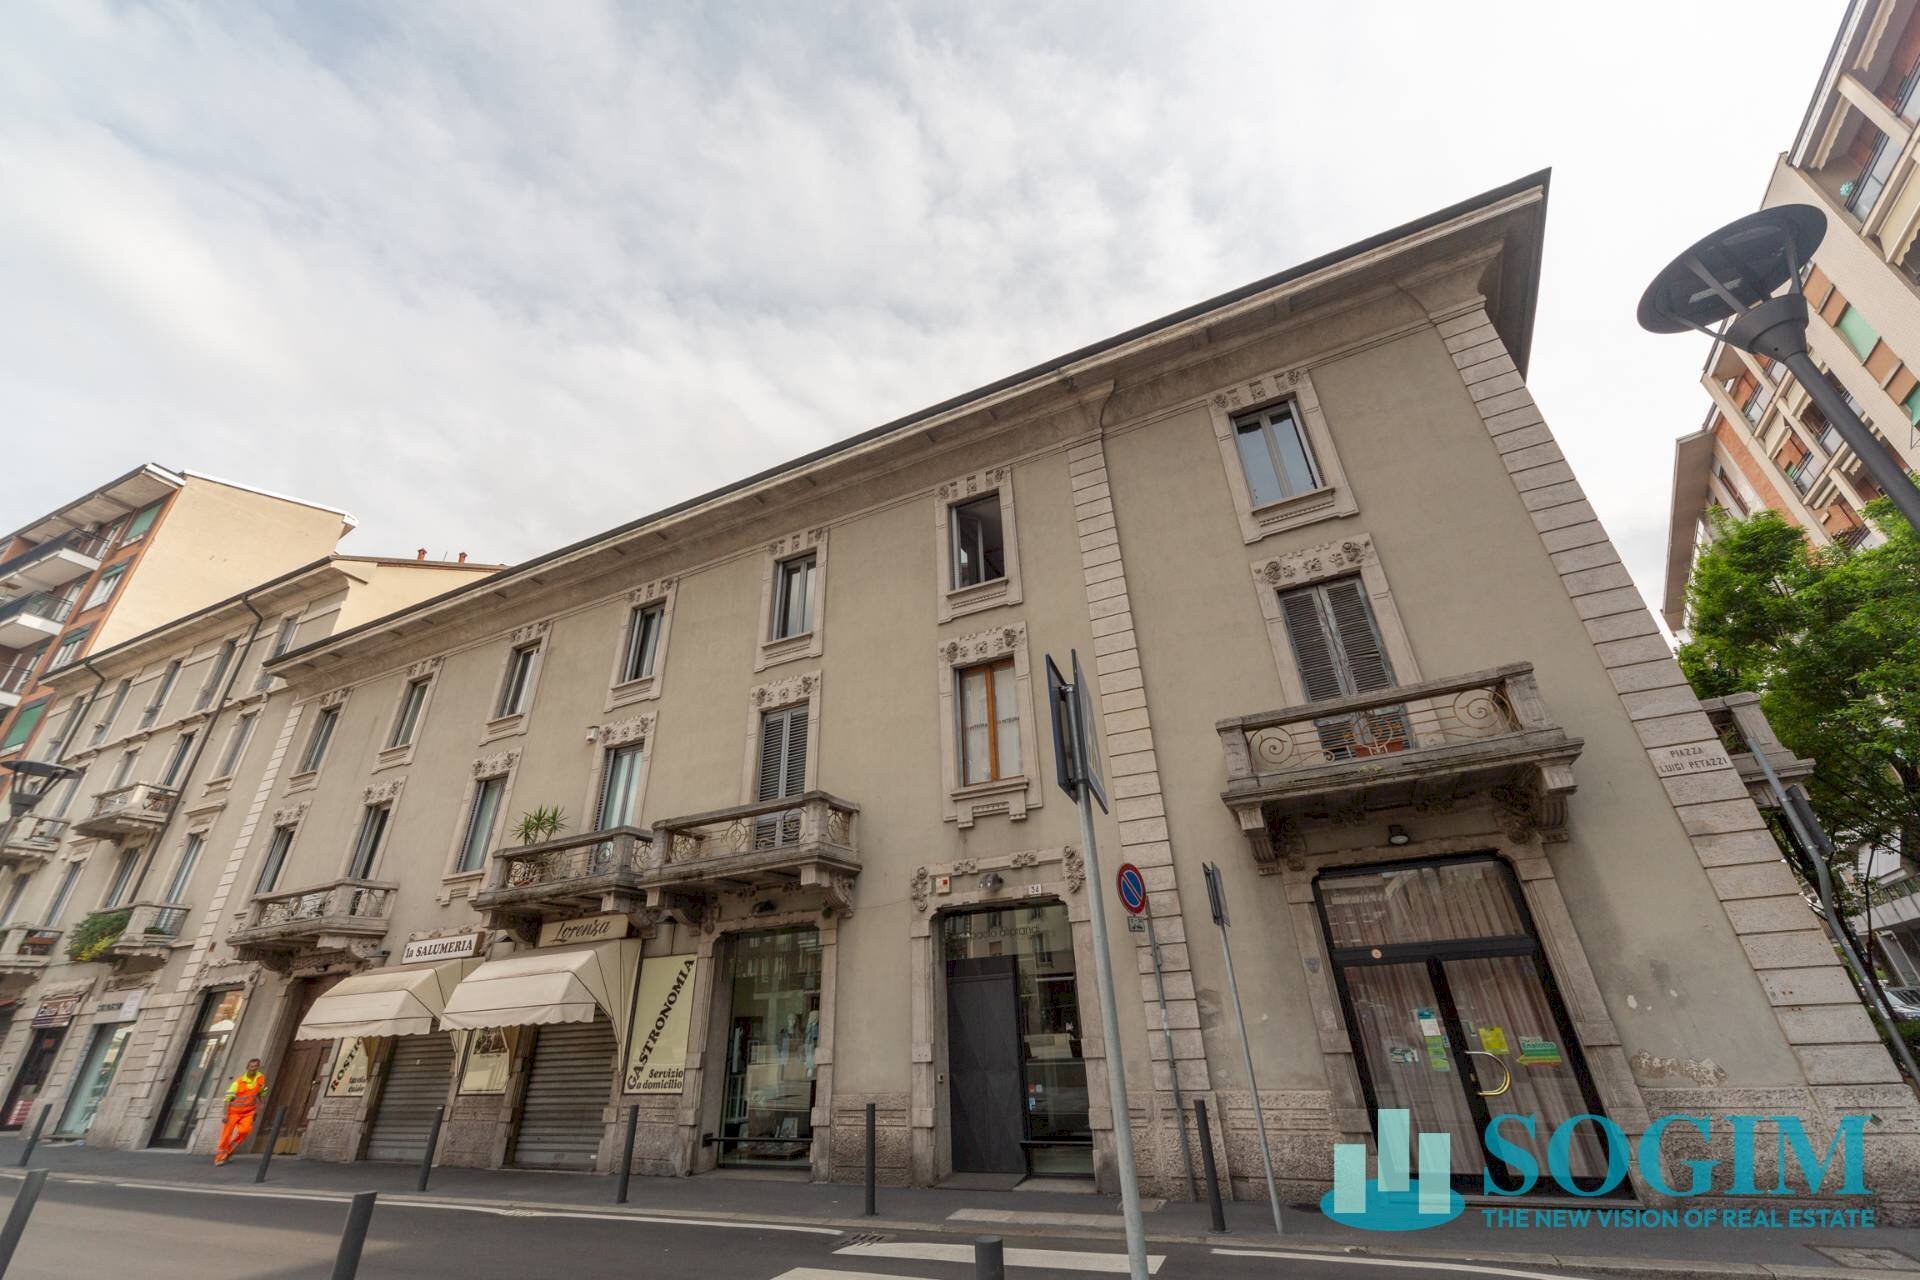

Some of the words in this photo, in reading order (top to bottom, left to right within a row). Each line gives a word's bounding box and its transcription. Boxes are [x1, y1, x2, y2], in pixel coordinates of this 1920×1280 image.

[1670, 747, 1704, 758] PIAZZA
[1660, 762, 1685, 773] LUIGI
[1688, 757, 1728, 768] PETAZZI
[553, 919, 611, 942] Lorenza
[415, 939, 473, 958] SALUMERIA
[626, 959, 695, 1090] GASTRONOMIA
[648, 1067, 684, 1079] Servizio
[642, 1079, 684, 1090] domicilio
